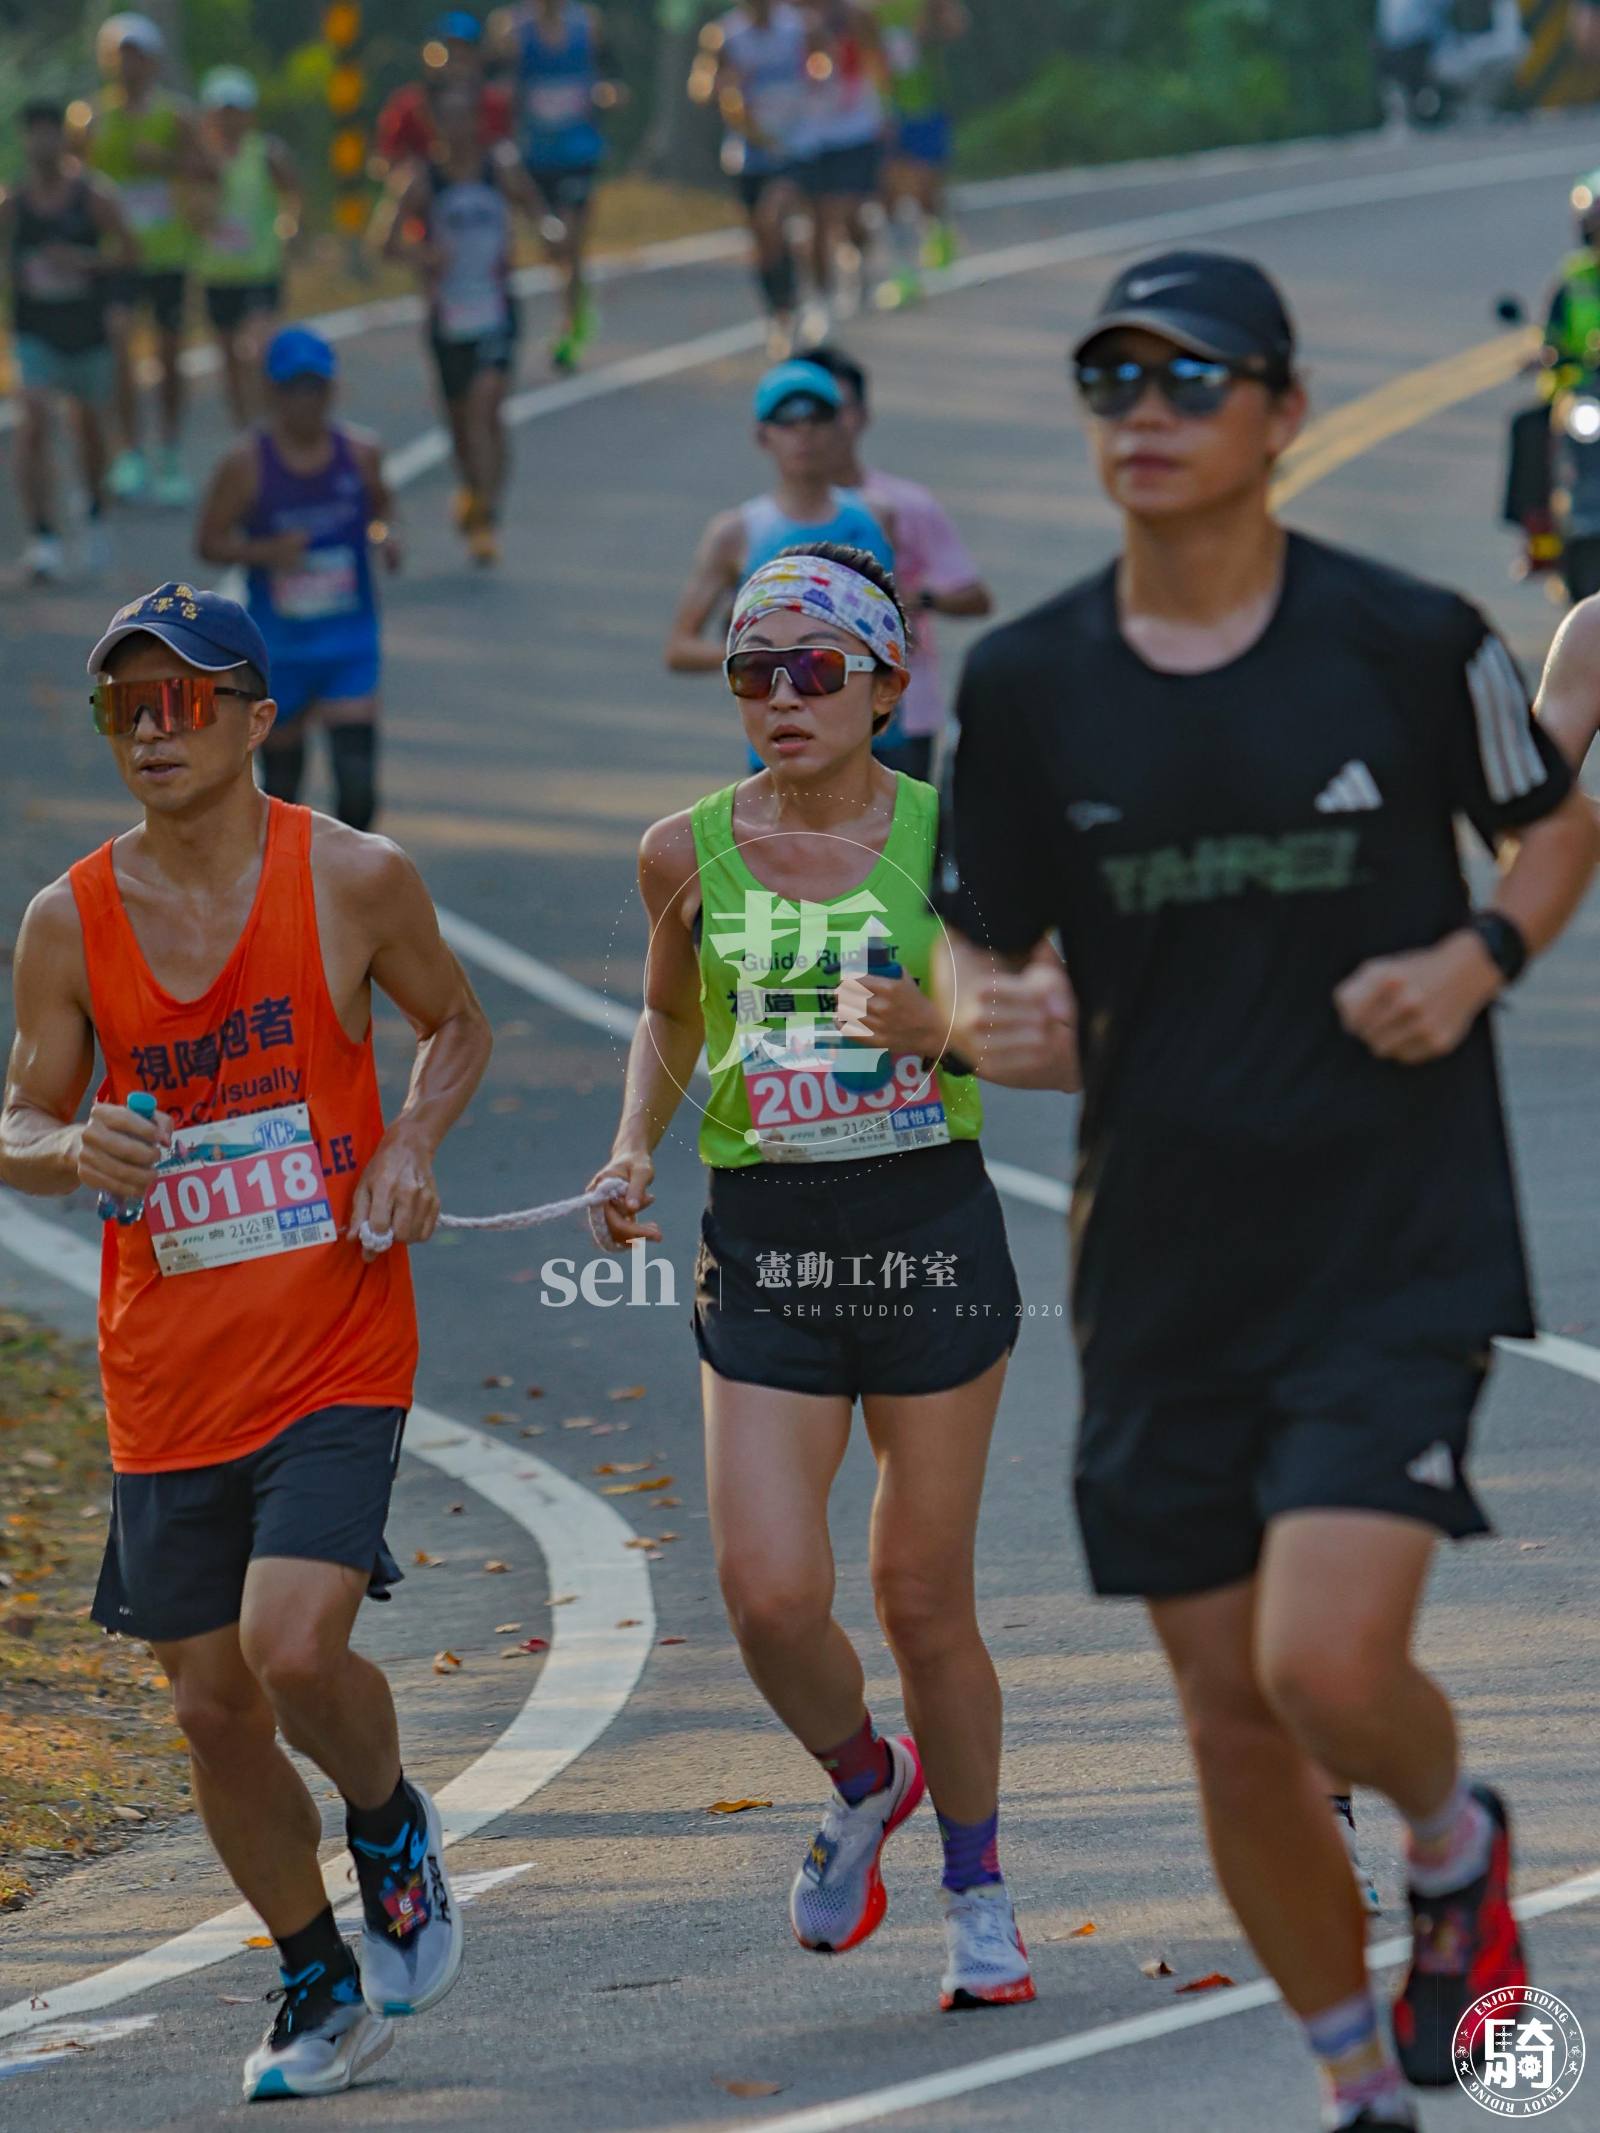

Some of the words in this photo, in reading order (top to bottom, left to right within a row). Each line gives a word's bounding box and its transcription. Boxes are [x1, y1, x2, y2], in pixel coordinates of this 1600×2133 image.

[742, 950, 808, 973] Guide
[149, 1151, 319, 1229] 10118
[229, 1215, 276, 1240] 21公里
